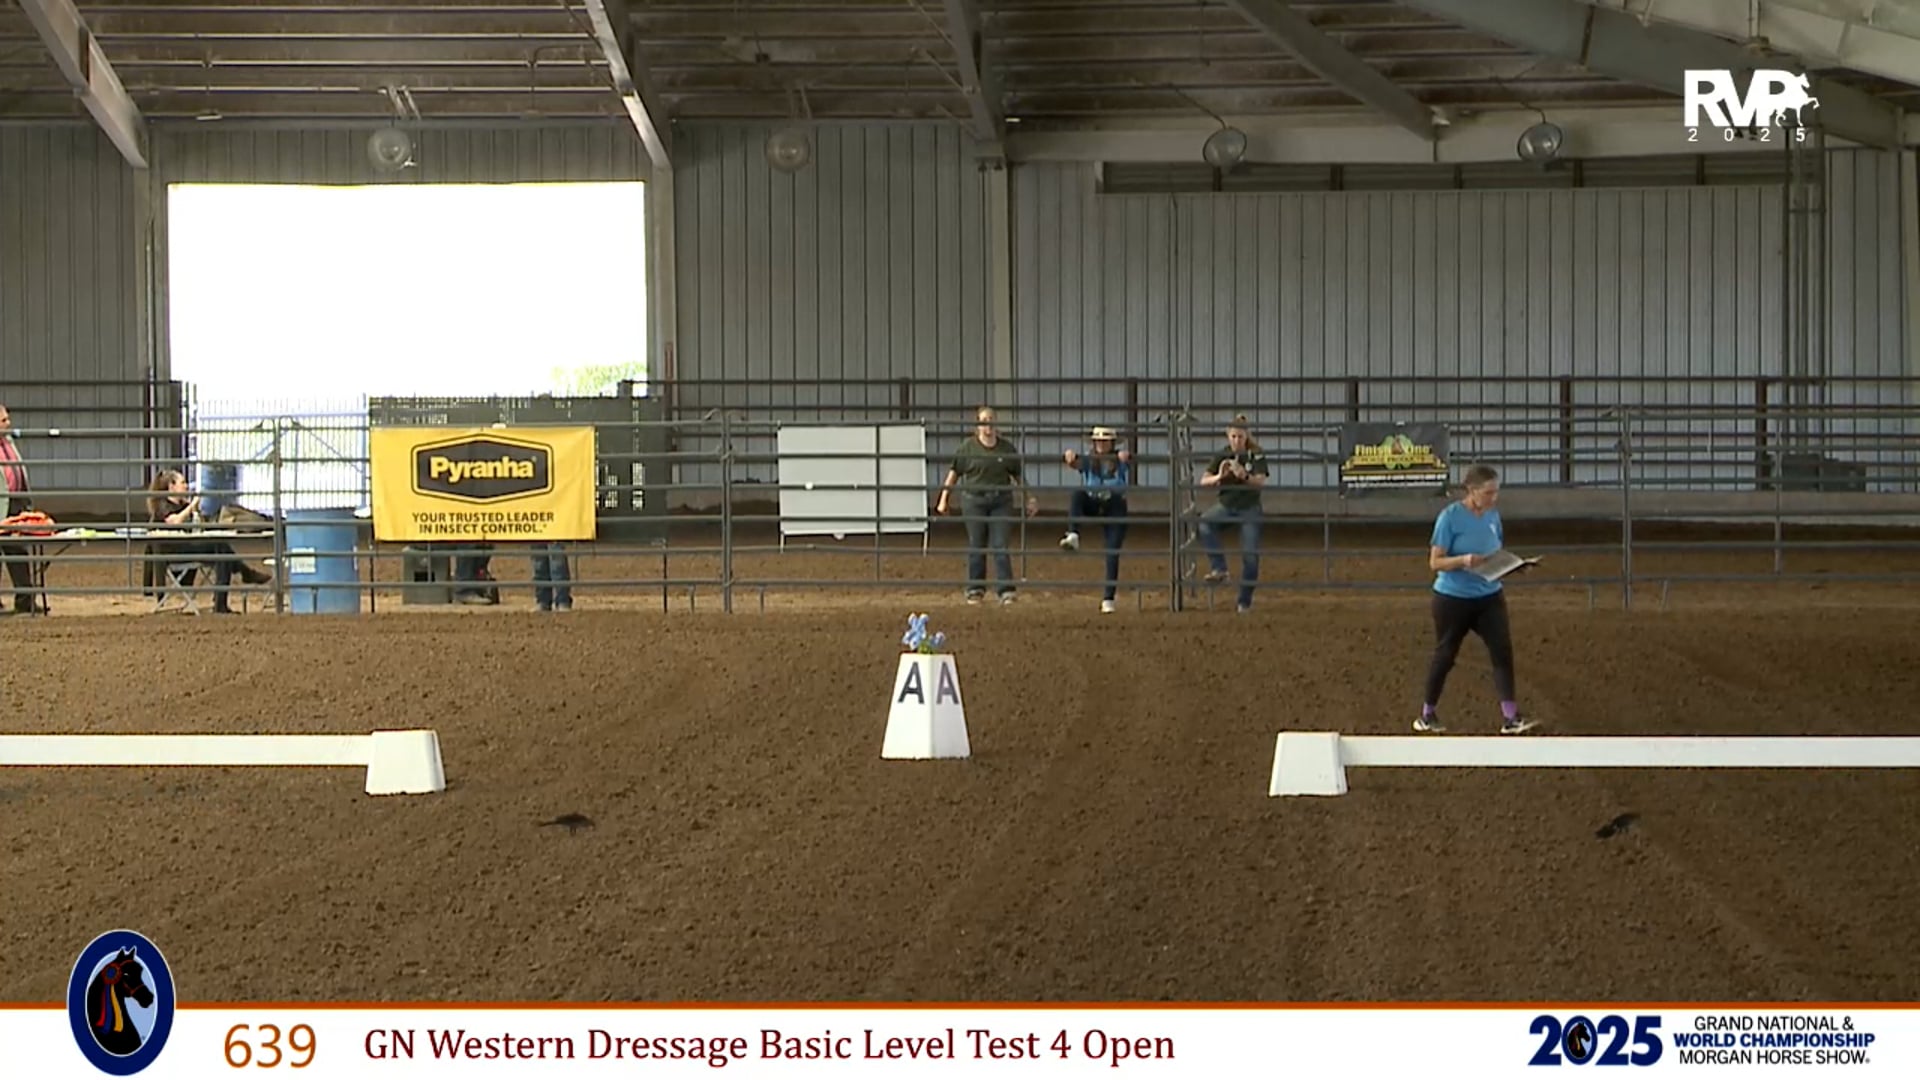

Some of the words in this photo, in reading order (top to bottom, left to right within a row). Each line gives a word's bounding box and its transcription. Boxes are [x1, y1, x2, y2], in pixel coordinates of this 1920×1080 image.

[429, 456, 534, 484] Pyranha
[412, 512, 447, 523] YOUR
[449, 512, 504, 523] TRUSTED
[507, 511, 555, 522] LEADER
[419, 523, 433, 534] IN
[435, 523, 478, 534] INSECT
[898, 661, 925, 704] A
[936, 661, 960, 705] A
